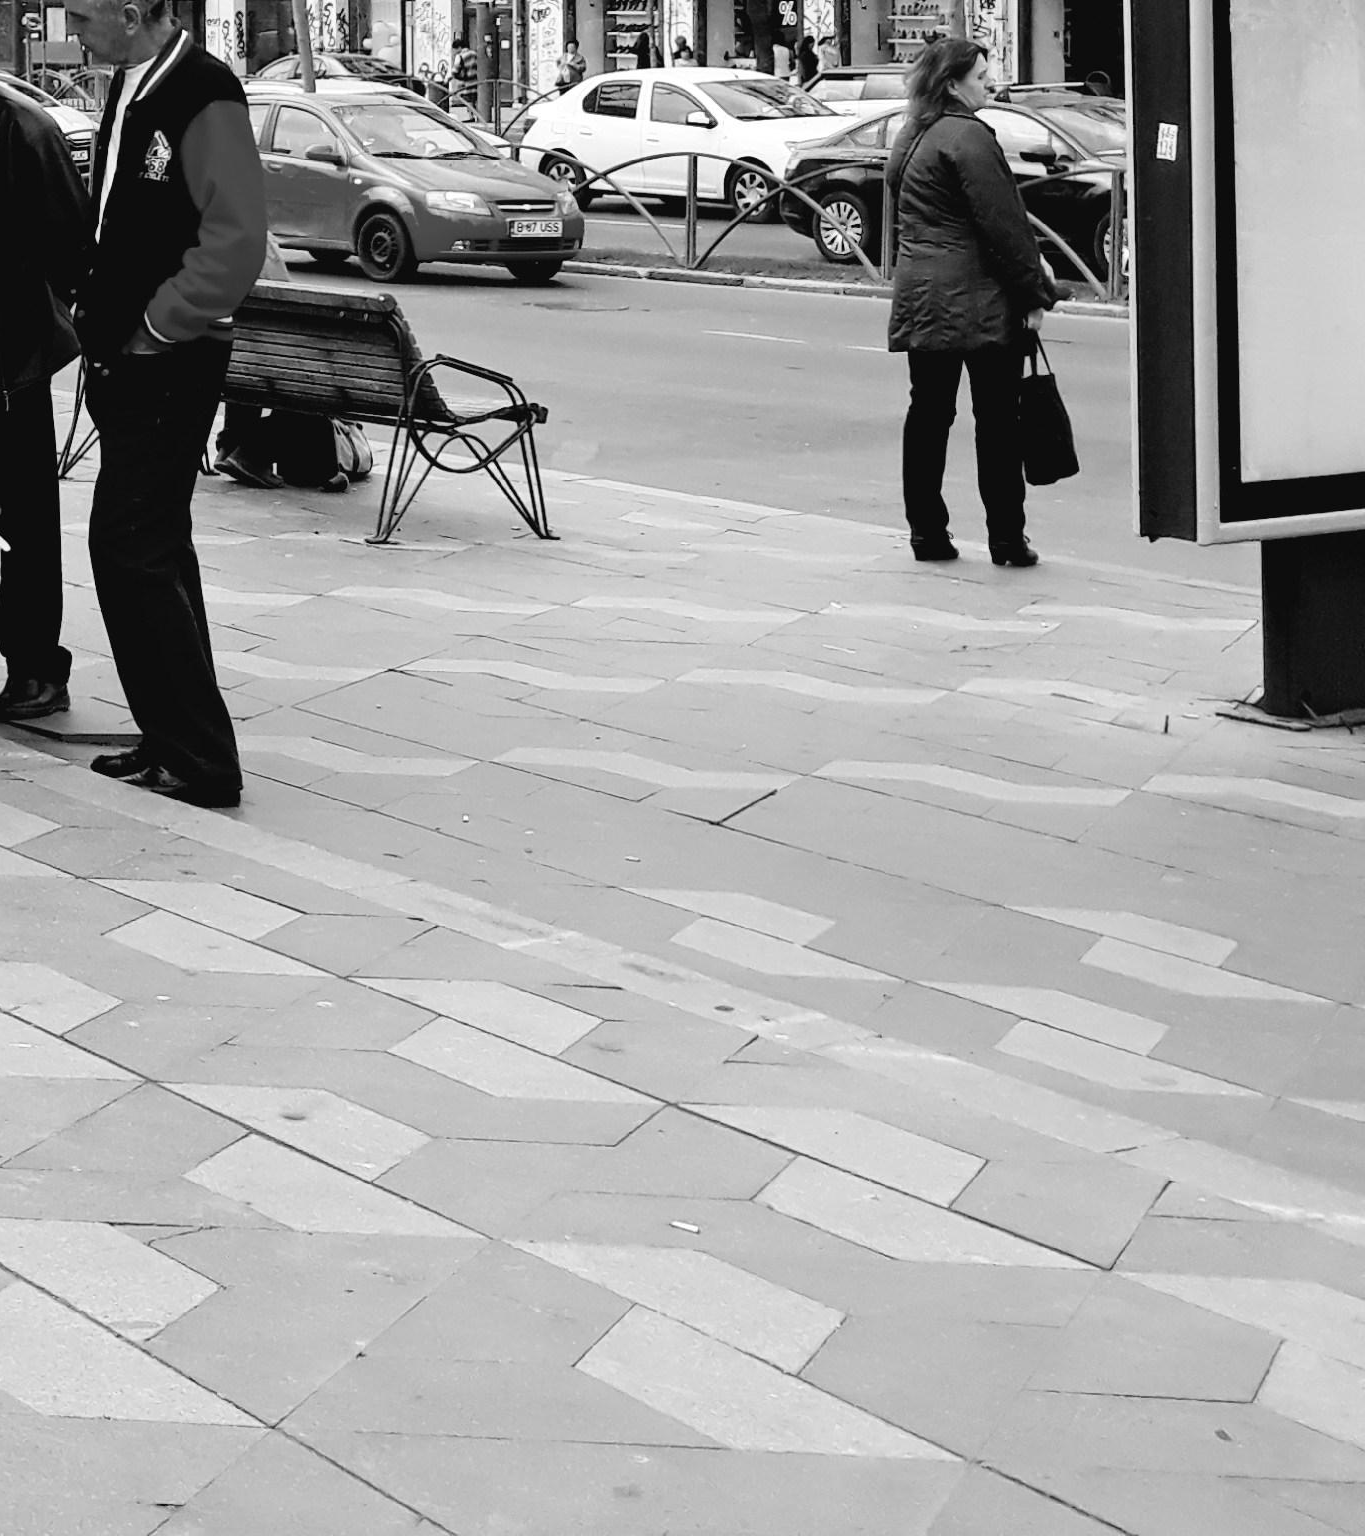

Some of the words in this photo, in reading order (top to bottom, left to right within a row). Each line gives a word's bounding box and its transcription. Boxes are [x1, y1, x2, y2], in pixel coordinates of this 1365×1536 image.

[149, 160, 165, 173] 68
[517, 222, 524, 233] B
[540, 222, 559, 233] USS
